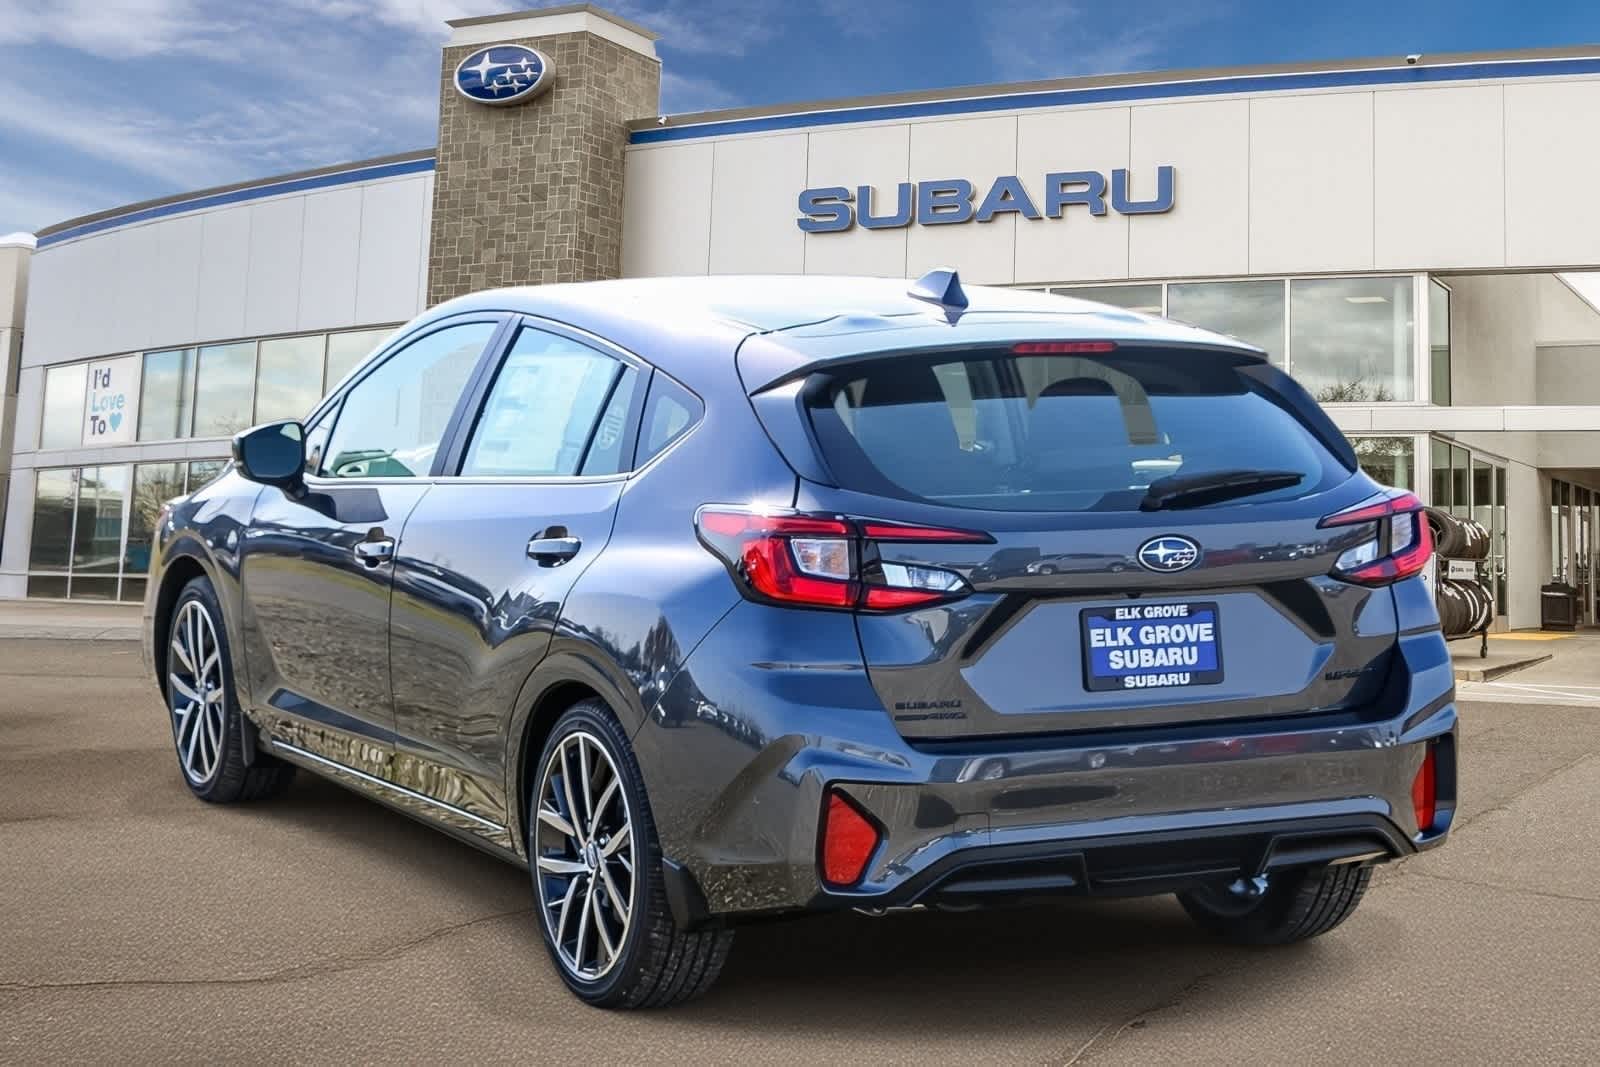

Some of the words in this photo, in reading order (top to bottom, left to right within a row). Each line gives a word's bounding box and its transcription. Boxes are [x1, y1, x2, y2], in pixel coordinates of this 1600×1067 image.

[797, 165, 1176, 233] SUBARU
[93, 368, 111, 389] I'd
[92, 391, 125, 412] Love
[90, 415, 106, 435] To
[1115, 607, 1141, 620] ELK
[1144, 605, 1188, 618] GROVE
[1090, 627, 1134, 648] ELK
[1139, 623, 1214, 645] GROVE
[1108, 646, 1198, 669] SUBARU
[1124, 672, 1190, 688] SUBARU
[895, 700, 961, 710] UBARU
